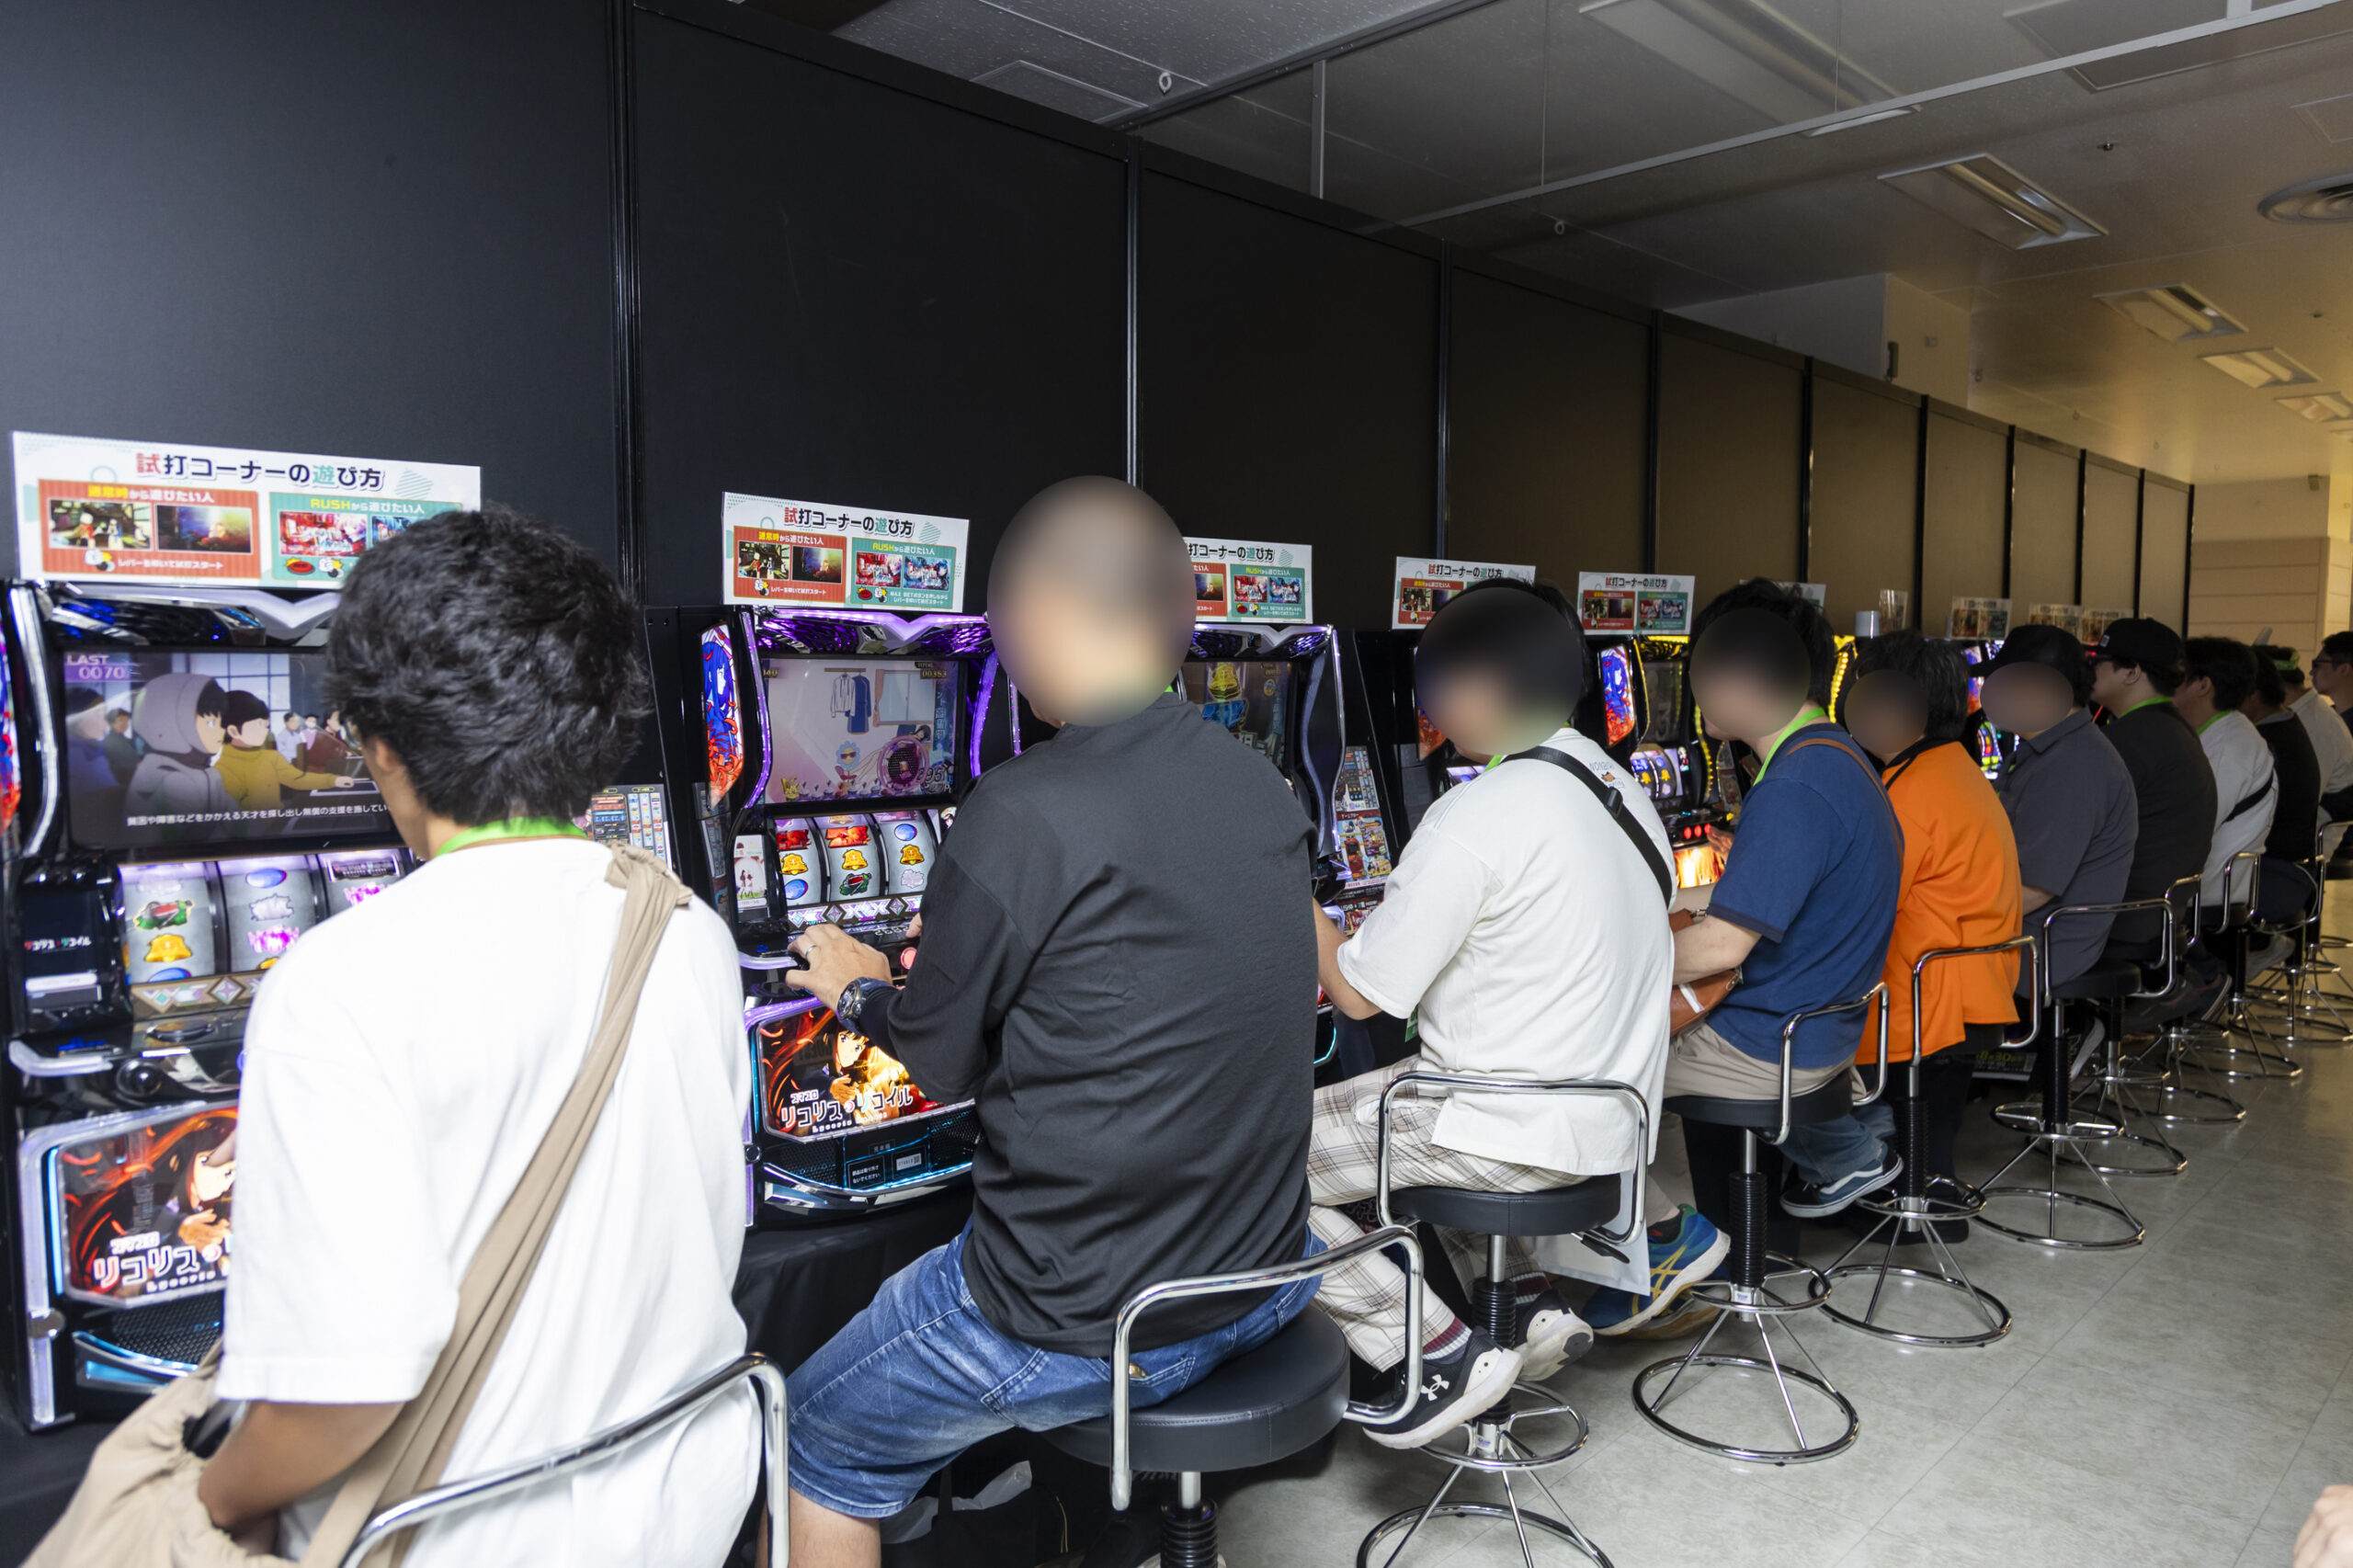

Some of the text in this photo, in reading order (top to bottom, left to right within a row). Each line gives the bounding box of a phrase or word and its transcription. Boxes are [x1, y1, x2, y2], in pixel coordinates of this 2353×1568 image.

[136, 452, 383, 489] 試打コーナーの遊び方
[784, 506, 914, 536] 試打コーナーの遊び方
[1185, 542, 1275, 561] 打コーナーの遊び方
[1427, 563, 1503, 578] 試打コーナーの遊び方
[66, 653, 109, 665] LAST
[78, 666, 126, 679] 0070
[127, 803, 392, 826] 貧困や障害などをかかえる天才を探し出し無償の支援を施してい
